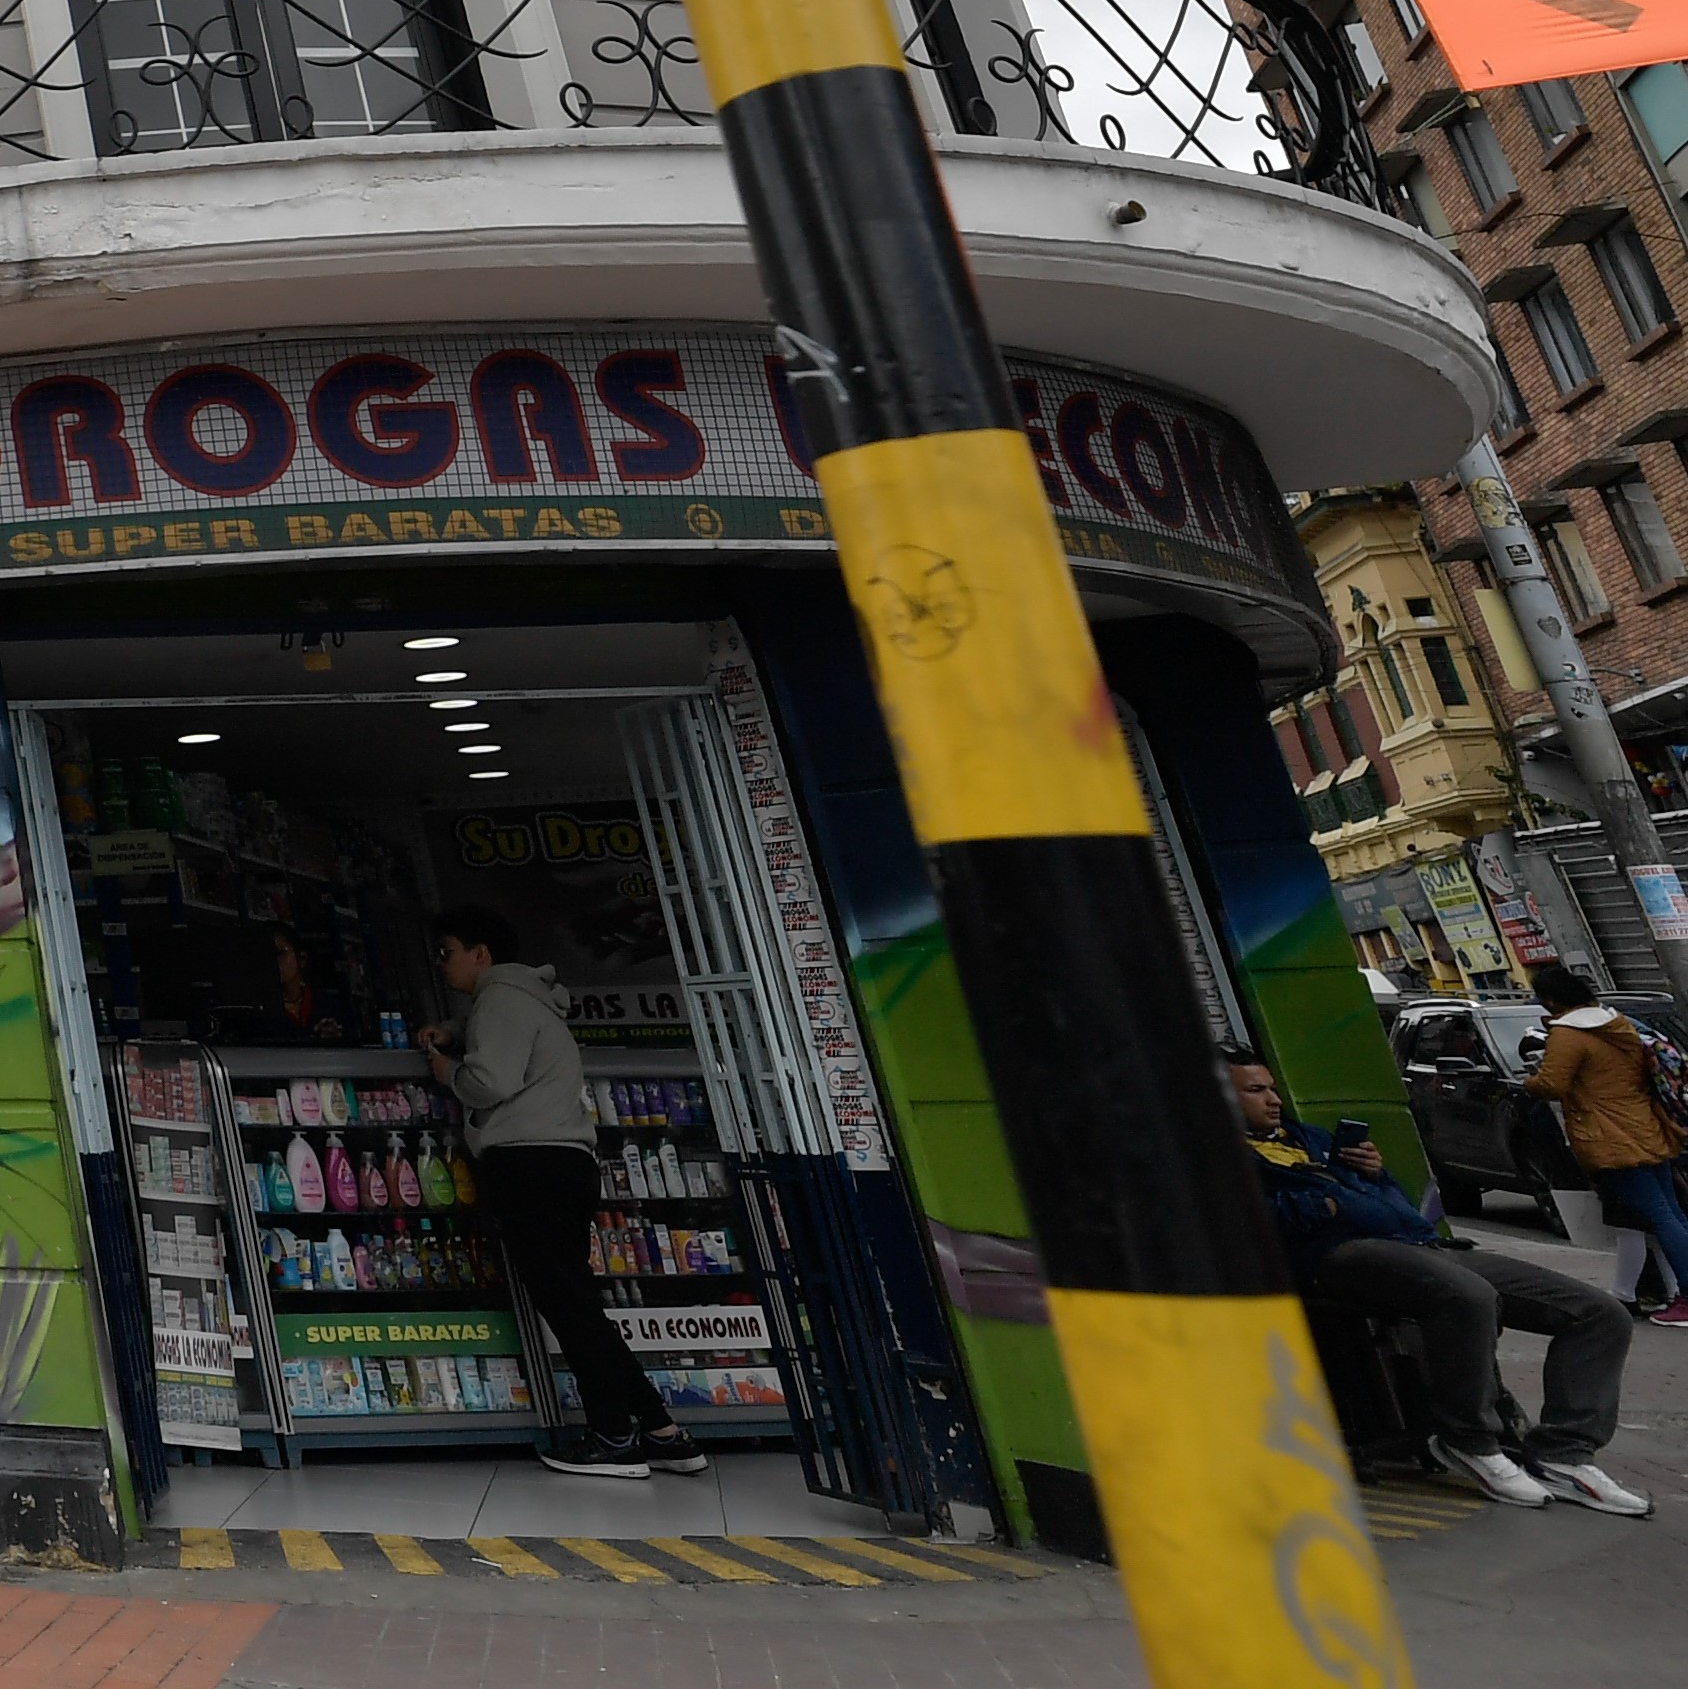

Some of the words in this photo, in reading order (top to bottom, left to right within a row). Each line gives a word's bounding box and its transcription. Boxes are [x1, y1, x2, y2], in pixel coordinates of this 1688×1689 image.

[10, 517, 264, 562] SUPER
[286, 506, 622, 548] BARATAS
[460, 816, 528, 864] Su
[638, 992, 680, 1020] LA
[306, 1325, 383, 1343] SUPER
[387, 1323, 491, 1342] BARATAS
[639, 1319, 662, 1340] LA
[666, 1316, 763, 1339] ECONOMIA
